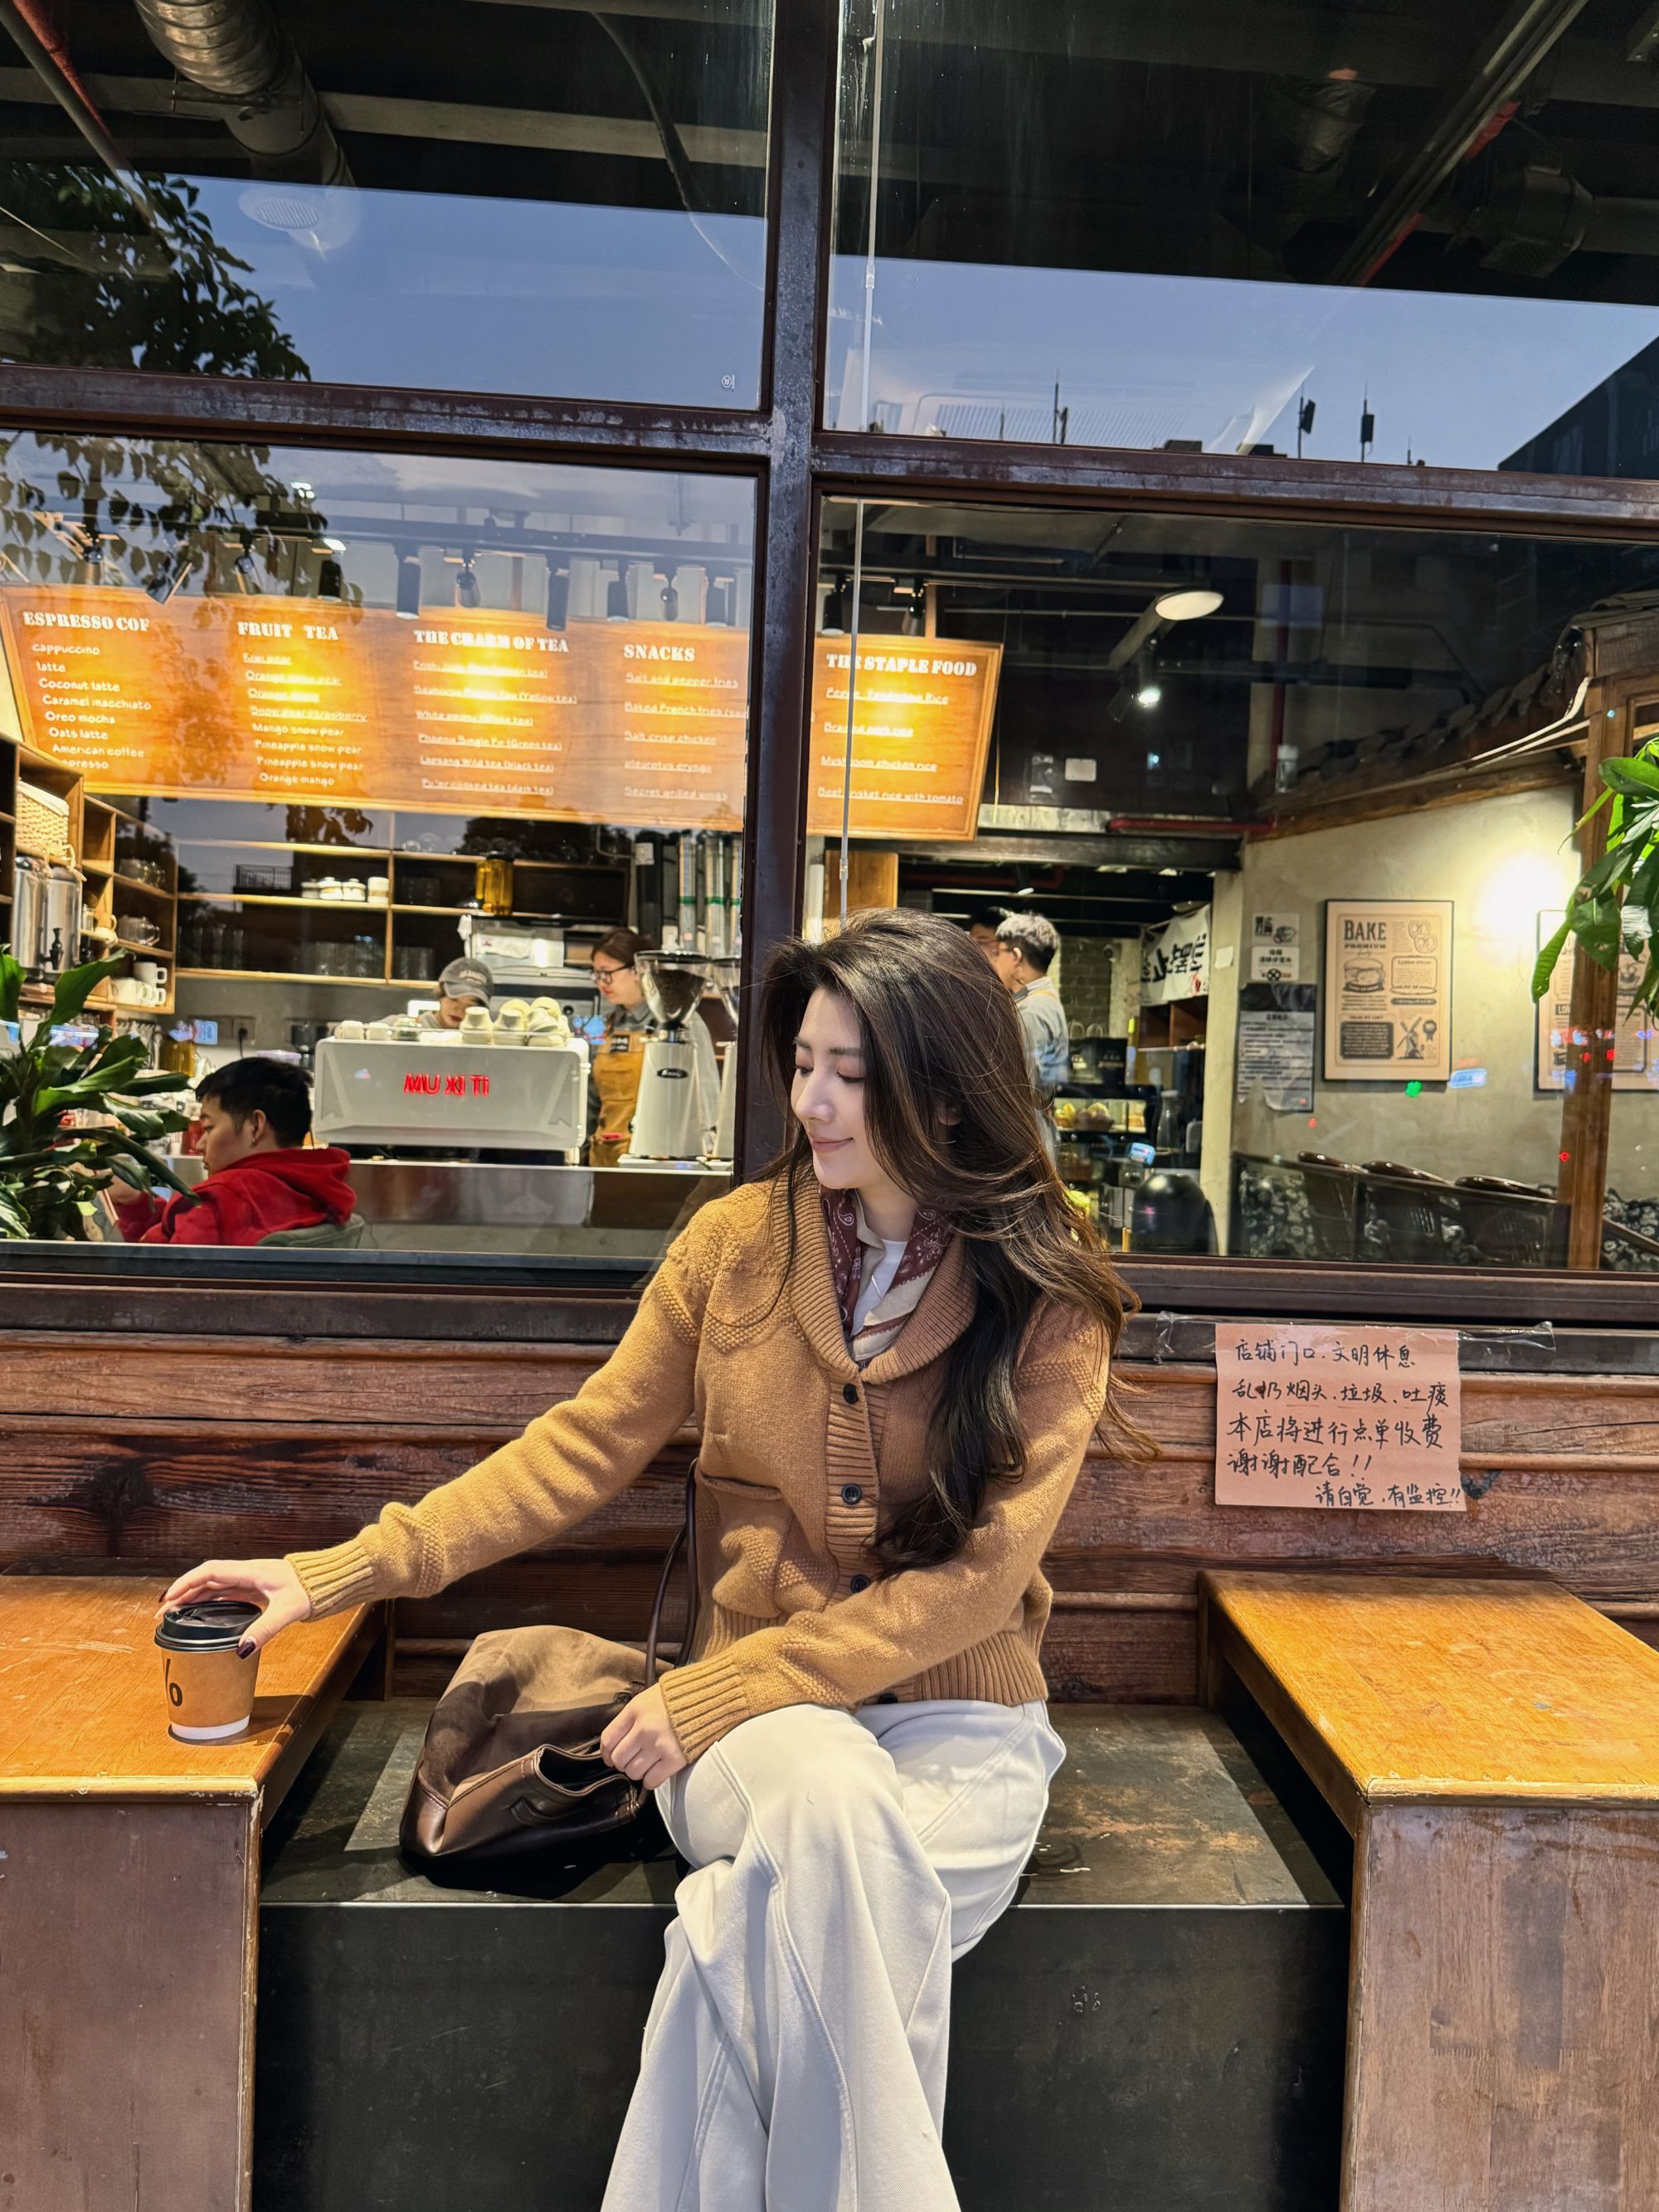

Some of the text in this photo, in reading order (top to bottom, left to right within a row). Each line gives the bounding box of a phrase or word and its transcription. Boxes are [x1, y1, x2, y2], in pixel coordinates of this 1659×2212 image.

[22, 611, 150, 631] ESPRESSO COF
[237, 621, 339, 641] FRUIT TEA
[32, 642, 100, 655] cappuccino
[413, 630, 450, 645] THE
[513, 636, 536, 650] OF
[538, 637, 569, 653] TEA
[623, 644, 696, 662] SNACKS
[36, 661, 66, 673] latte
[826, 654, 978, 676] THE STAPLE FOOD
[38, 677, 120, 692] Coconut latte
[42, 694, 152, 711] Caramel macchiato
[45, 710, 116, 724] Oreo mocha
[80, 729, 109, 740] latte
[251, 723, 289, 735] Mango
[52, 743, 105, 756] American
[254, 738, 306, 752] Pineapple
[300, 776, 335, 787] mango
[1345, 919, 1386, 941] BAKE
[404, 1072, 440, 1095] MU
[444, 1074, 466, 1096] XI
[1227, 1411, 1443, 1449] 本店将进行点单收费
